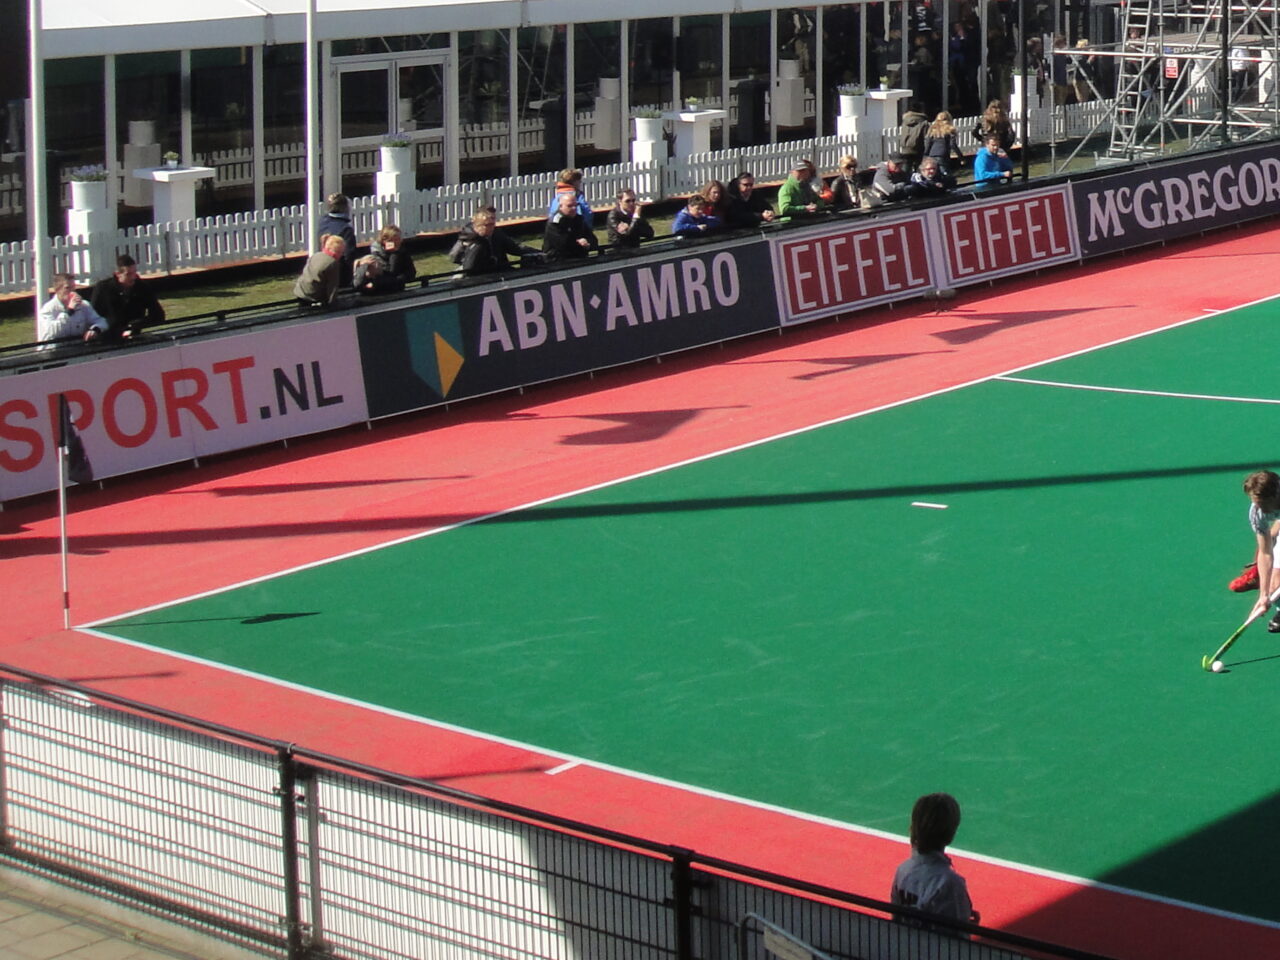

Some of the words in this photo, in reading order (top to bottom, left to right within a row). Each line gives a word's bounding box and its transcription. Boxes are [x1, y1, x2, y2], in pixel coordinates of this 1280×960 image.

[791, 226, 925, 310] EIFFEL
[950, 198, 1066, 275] EIFFEL
[0, 355, 345, 473] SPORT.NL
